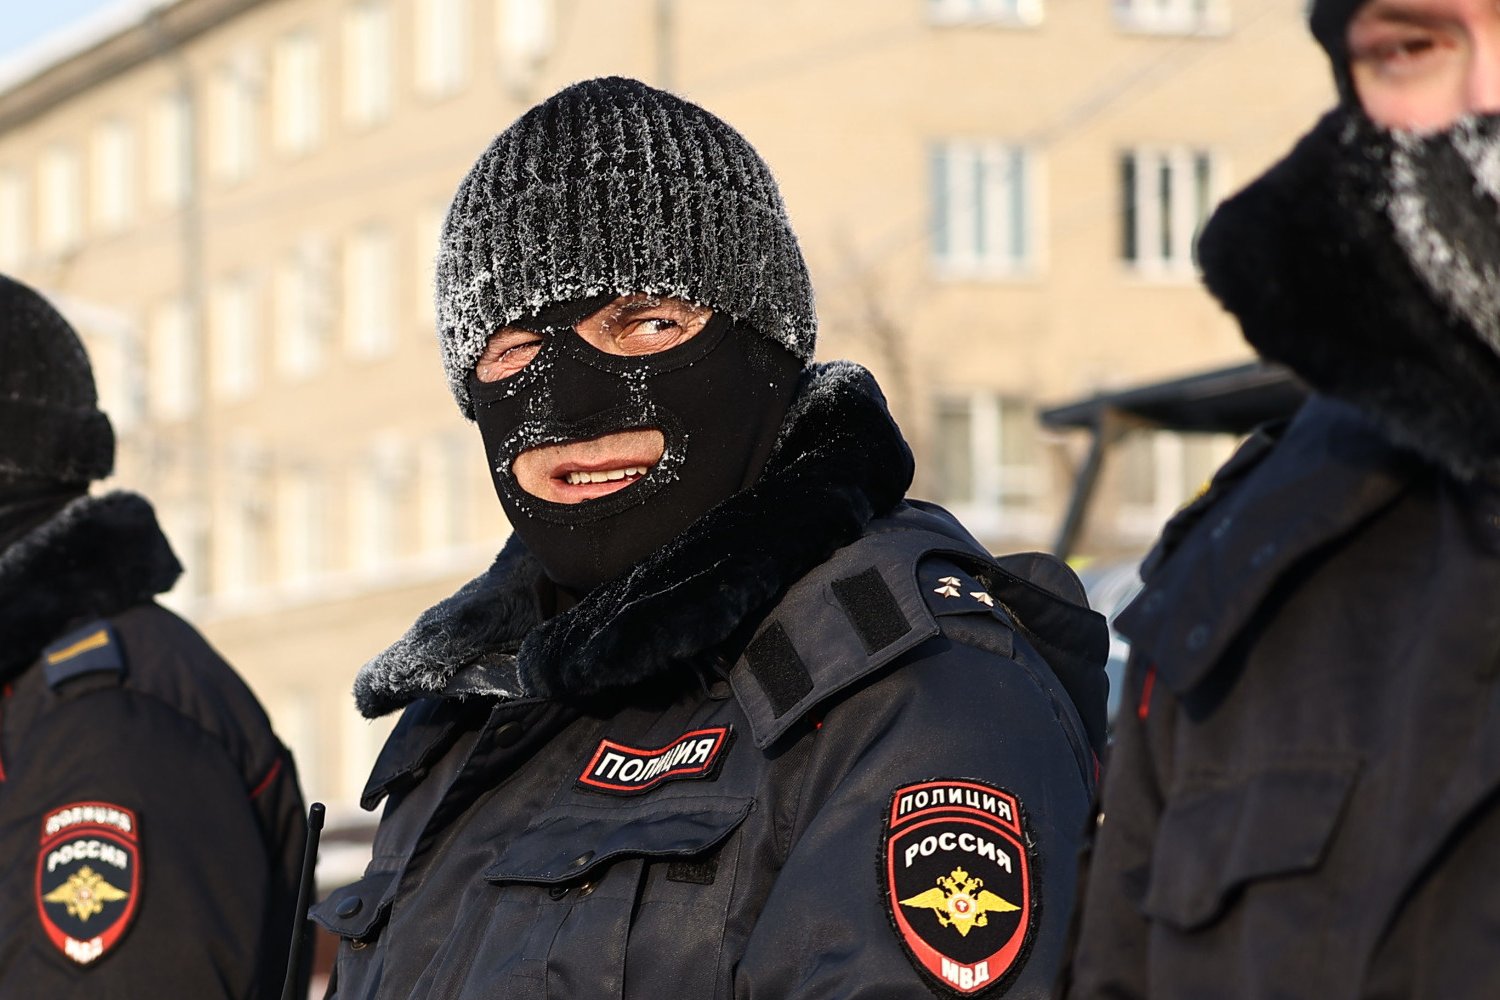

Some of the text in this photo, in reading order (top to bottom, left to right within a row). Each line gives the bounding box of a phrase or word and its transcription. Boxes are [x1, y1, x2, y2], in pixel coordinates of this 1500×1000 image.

[595, 738, 716, 782] ПОЛИЦИЯ
[899, 788, 1012, 821] ПОЛИЦИЯ
[48, 840, 128, 872] РОССИЯ
[904, 832, 1012, 873] РОССИЯ
[941, 957, 990, 990] МВД
